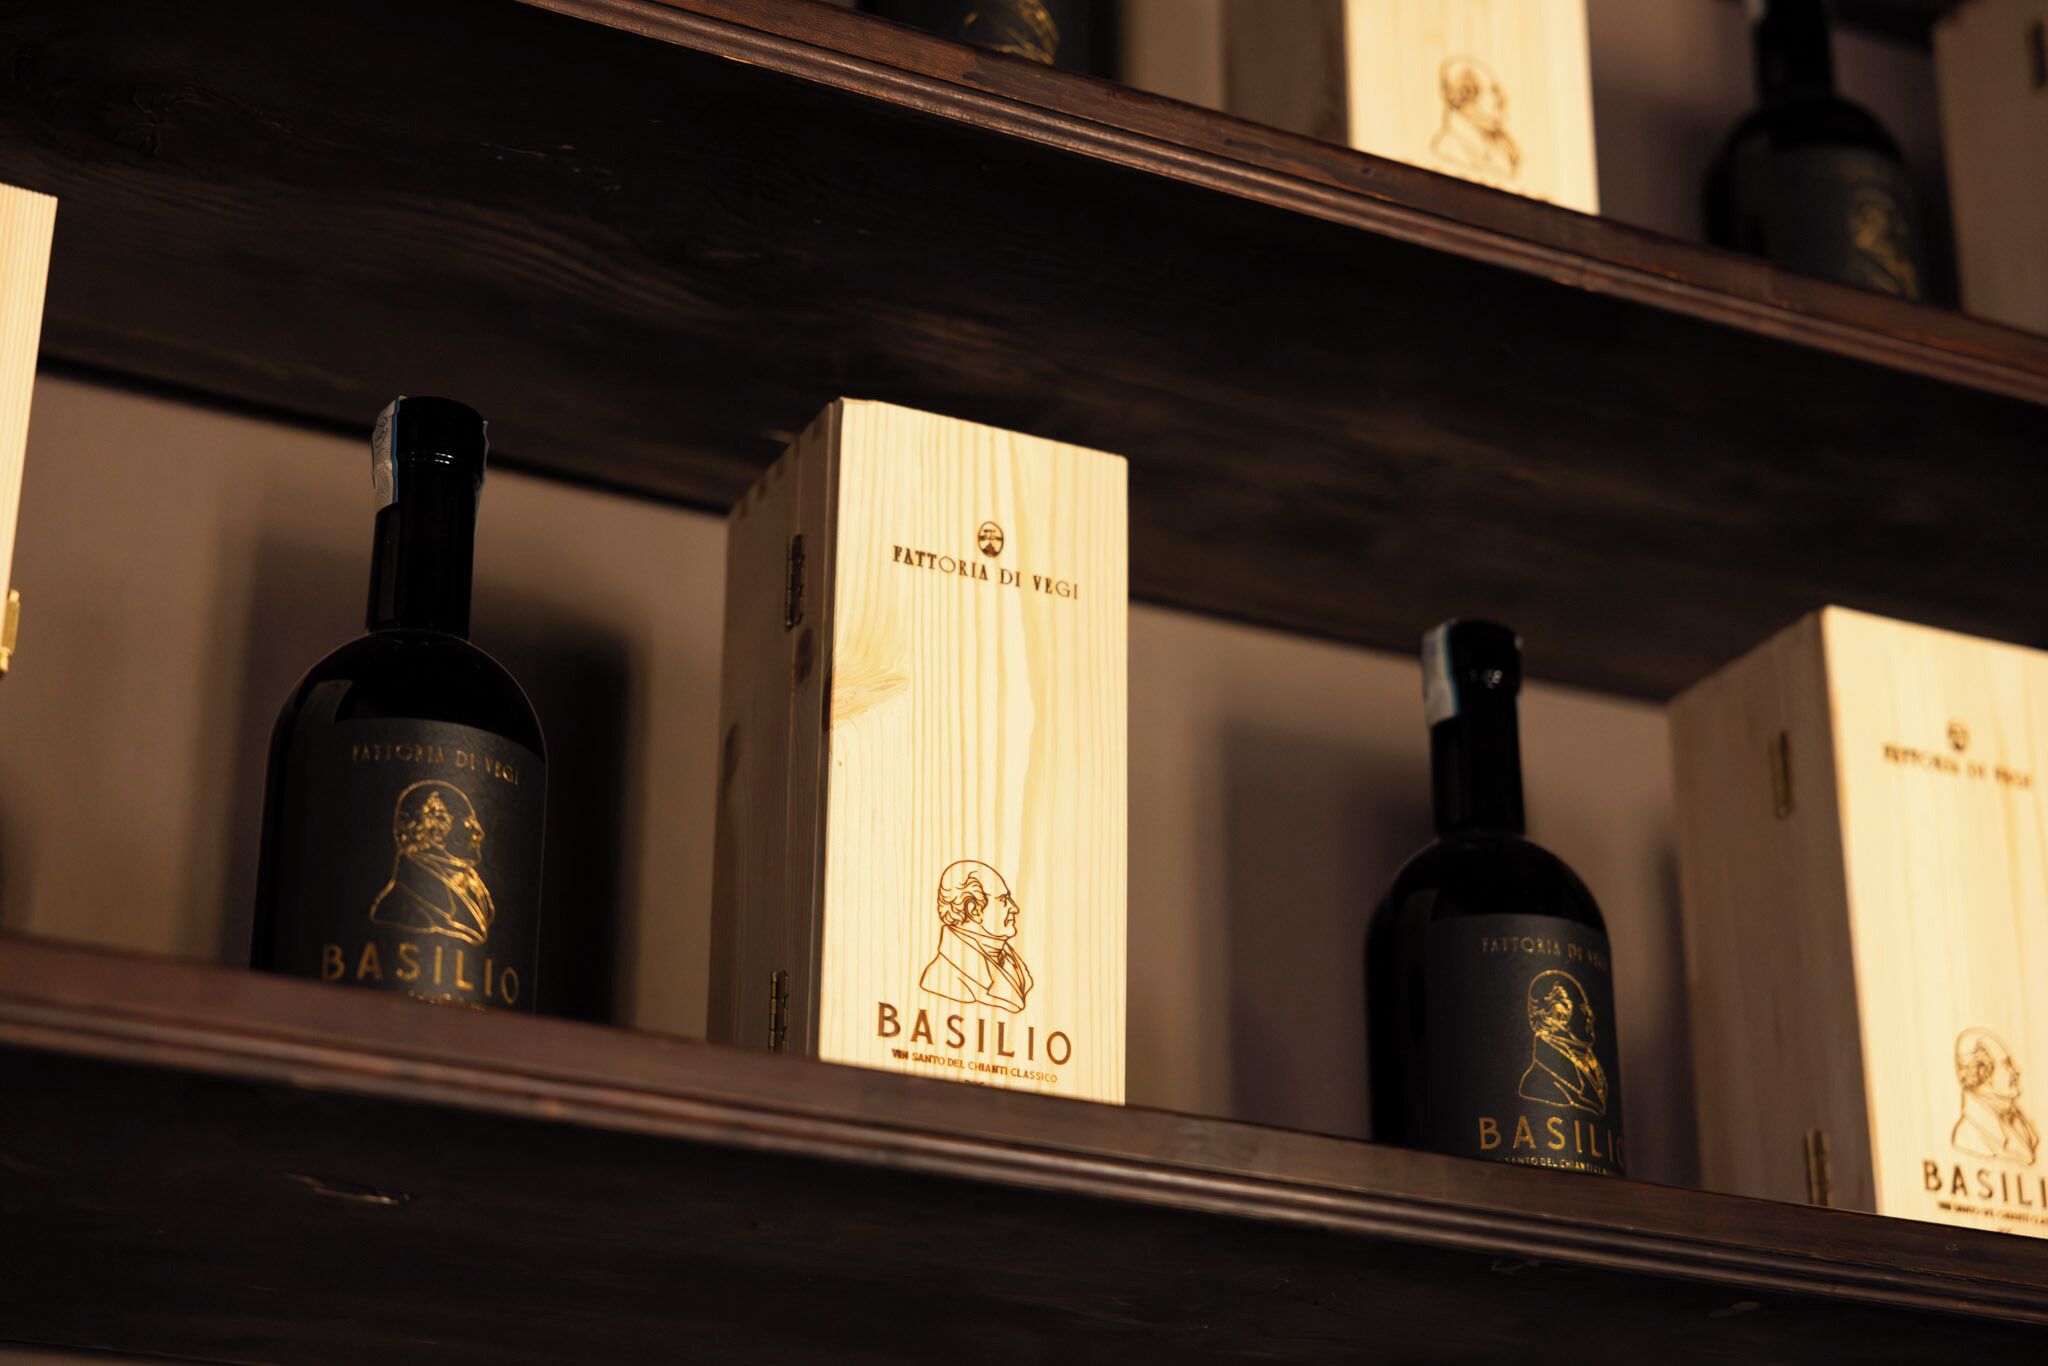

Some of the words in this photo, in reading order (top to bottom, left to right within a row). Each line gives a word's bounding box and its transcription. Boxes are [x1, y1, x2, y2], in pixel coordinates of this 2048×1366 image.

[892, 545, 989, 582] FATTORIA
[1000, 567, 1021, 588] DI
[1033, 575, 1079, 600] VEGI
[351, 743, 445, 765] FATTORIA
[455, 750, 476, 770] DI
[485, 757, 520, 785] VEGI
[321, 941, 520, 1005] BASILIO
[876, 1001, 1072, 1066] BASILIO
[911, 1052, 946, 1066] SANTO
[947, 1057, 966, 1069] DEL
[968, 1061, 1009, 1076] CHIANTI
[1010, 1067, 1058, 1084] CLASSICO
